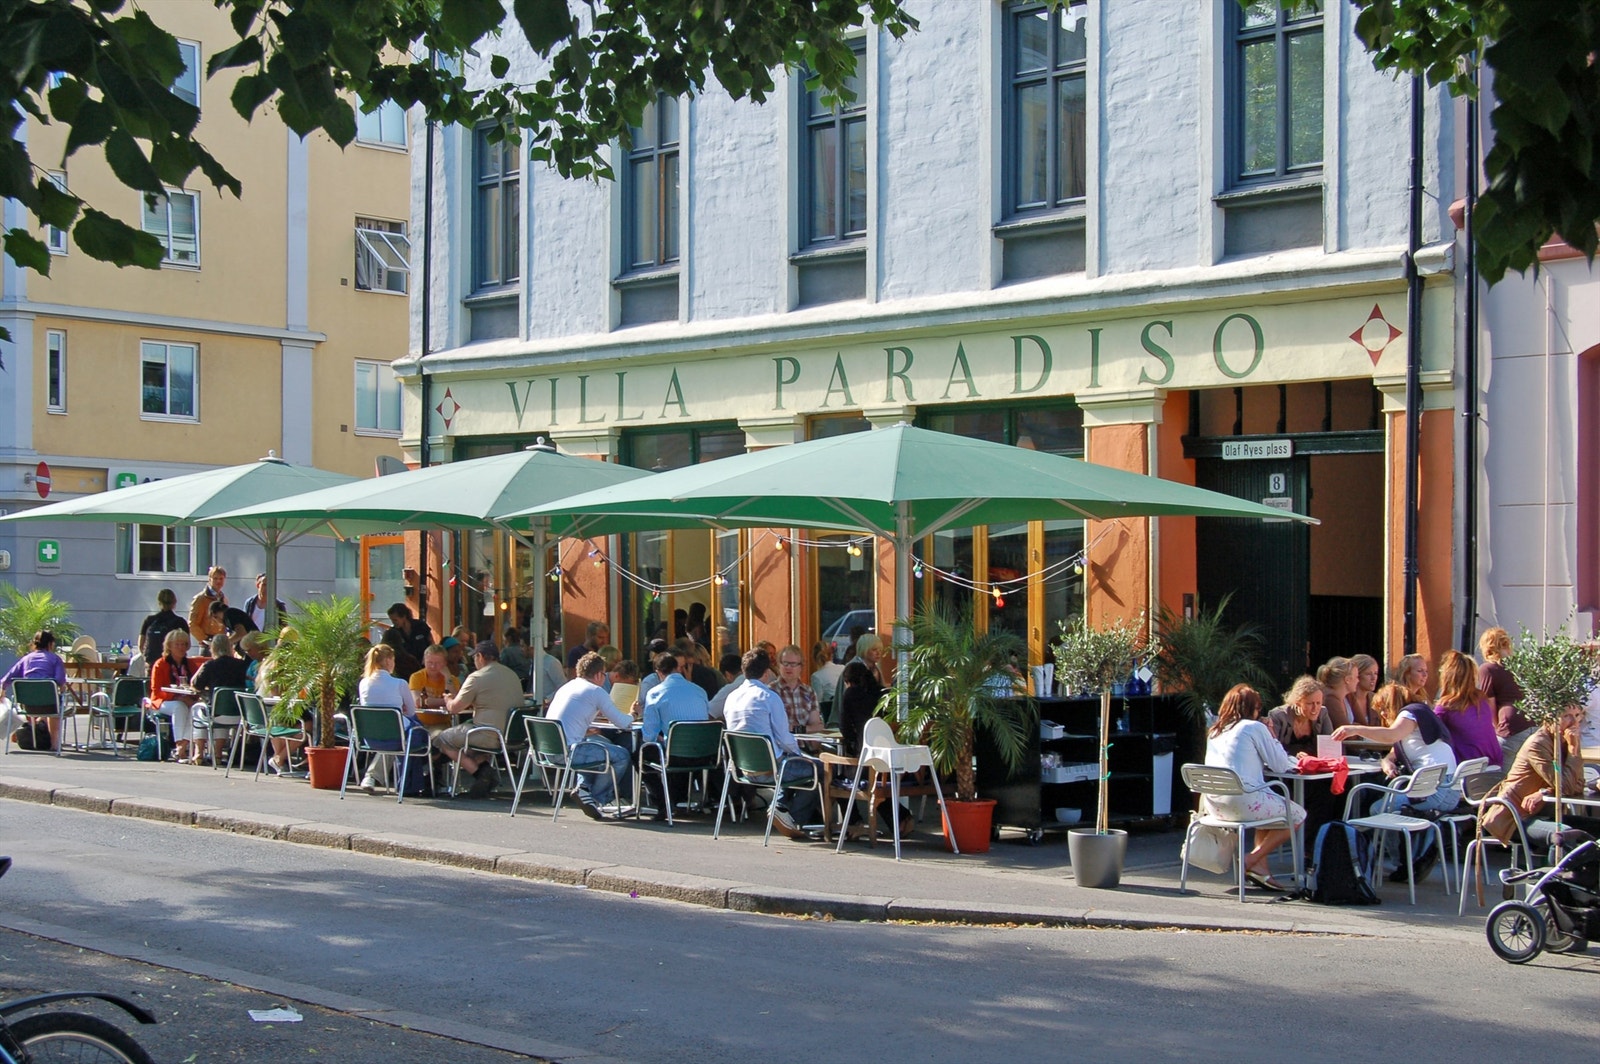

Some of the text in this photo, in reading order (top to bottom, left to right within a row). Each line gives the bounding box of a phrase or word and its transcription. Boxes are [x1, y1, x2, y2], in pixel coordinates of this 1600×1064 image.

[506, 313, 1265, 430] VILLA PARADISO
[1225, 443, 1288, 457] Olaf Ryes plass
[1273, 475, 1281, 491] 8
